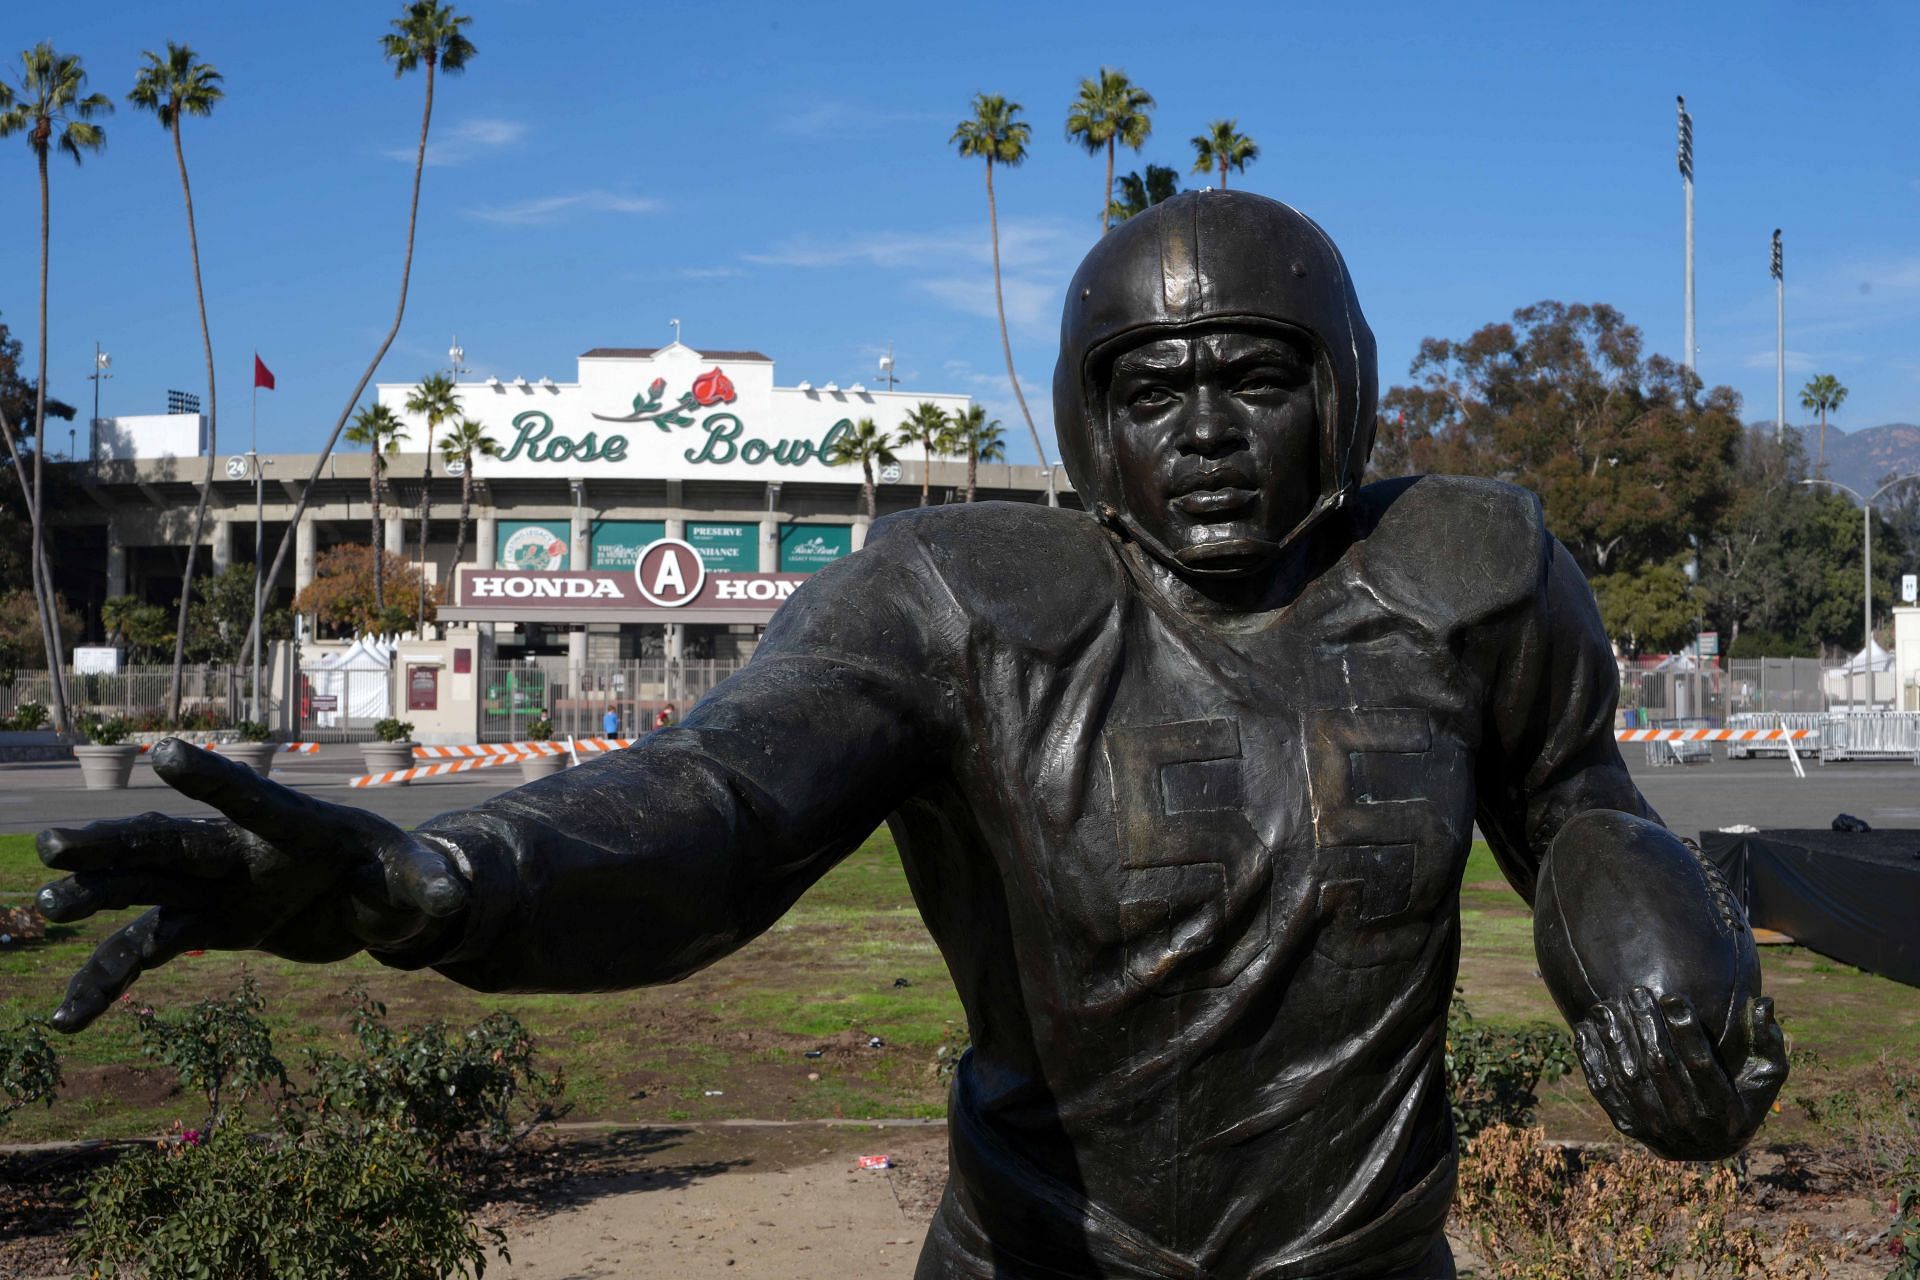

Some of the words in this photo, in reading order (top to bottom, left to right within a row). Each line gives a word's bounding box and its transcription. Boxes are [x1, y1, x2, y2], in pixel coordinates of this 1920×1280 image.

[494, 410, 629, 462] Rose
[684, 413, 858, 467] Bowl
[228, 461, 245, 475] 24
[881, 464, 900, 478] 26
[693, 527, 742, 536] PRESERVE
[696, 547, 740, 557] NHANCE
[653, 549, 686, 596] A
[472, 576, 625, 599] HONDA
